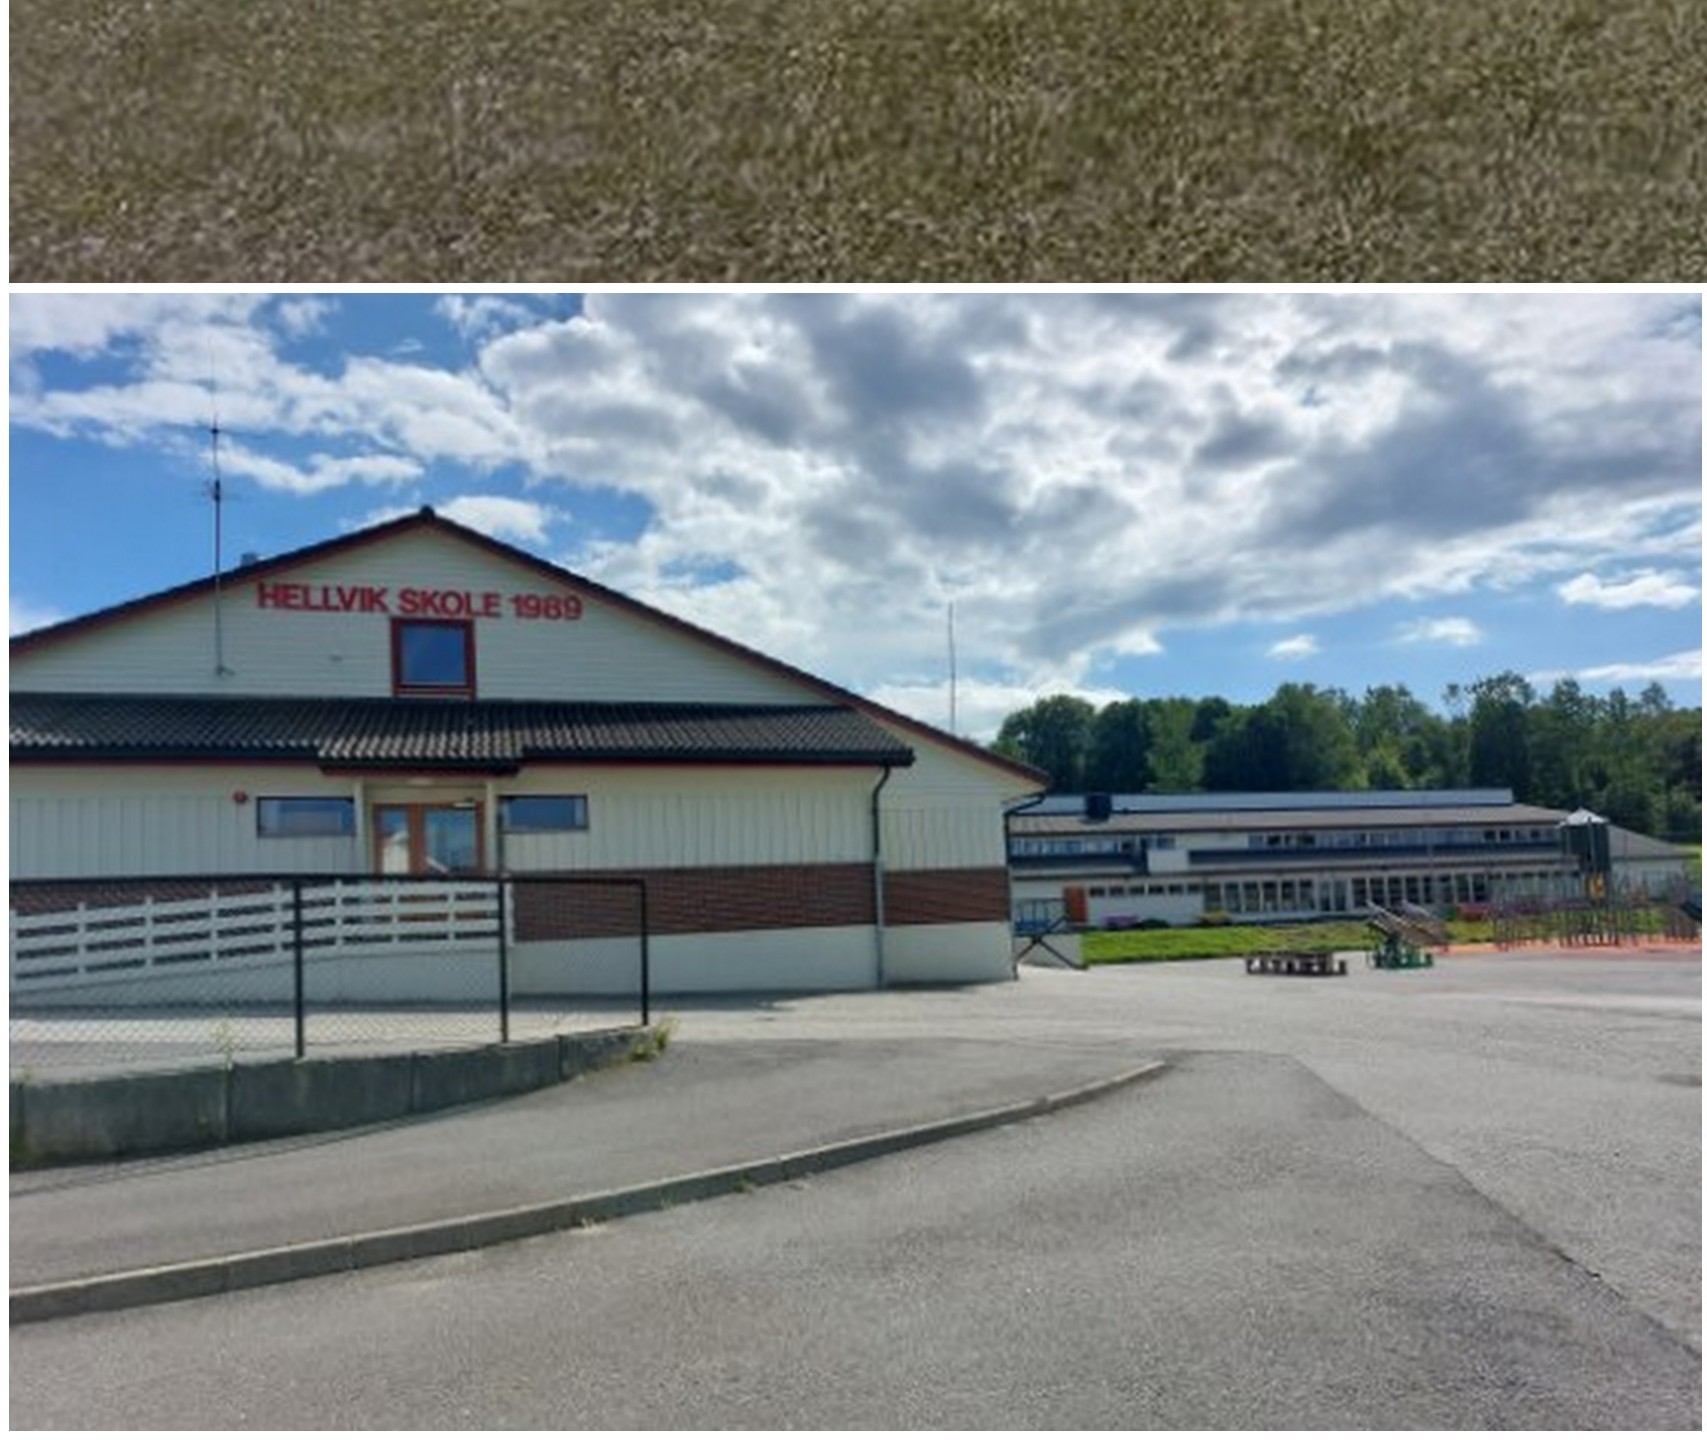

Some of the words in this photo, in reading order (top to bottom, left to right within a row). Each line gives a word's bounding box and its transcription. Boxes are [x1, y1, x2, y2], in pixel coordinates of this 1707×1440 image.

[257, 582, 389, 613] HELLVIK
[400, 587, 502, 618] SKOLE
[511, 595, 582, 621] 1989
